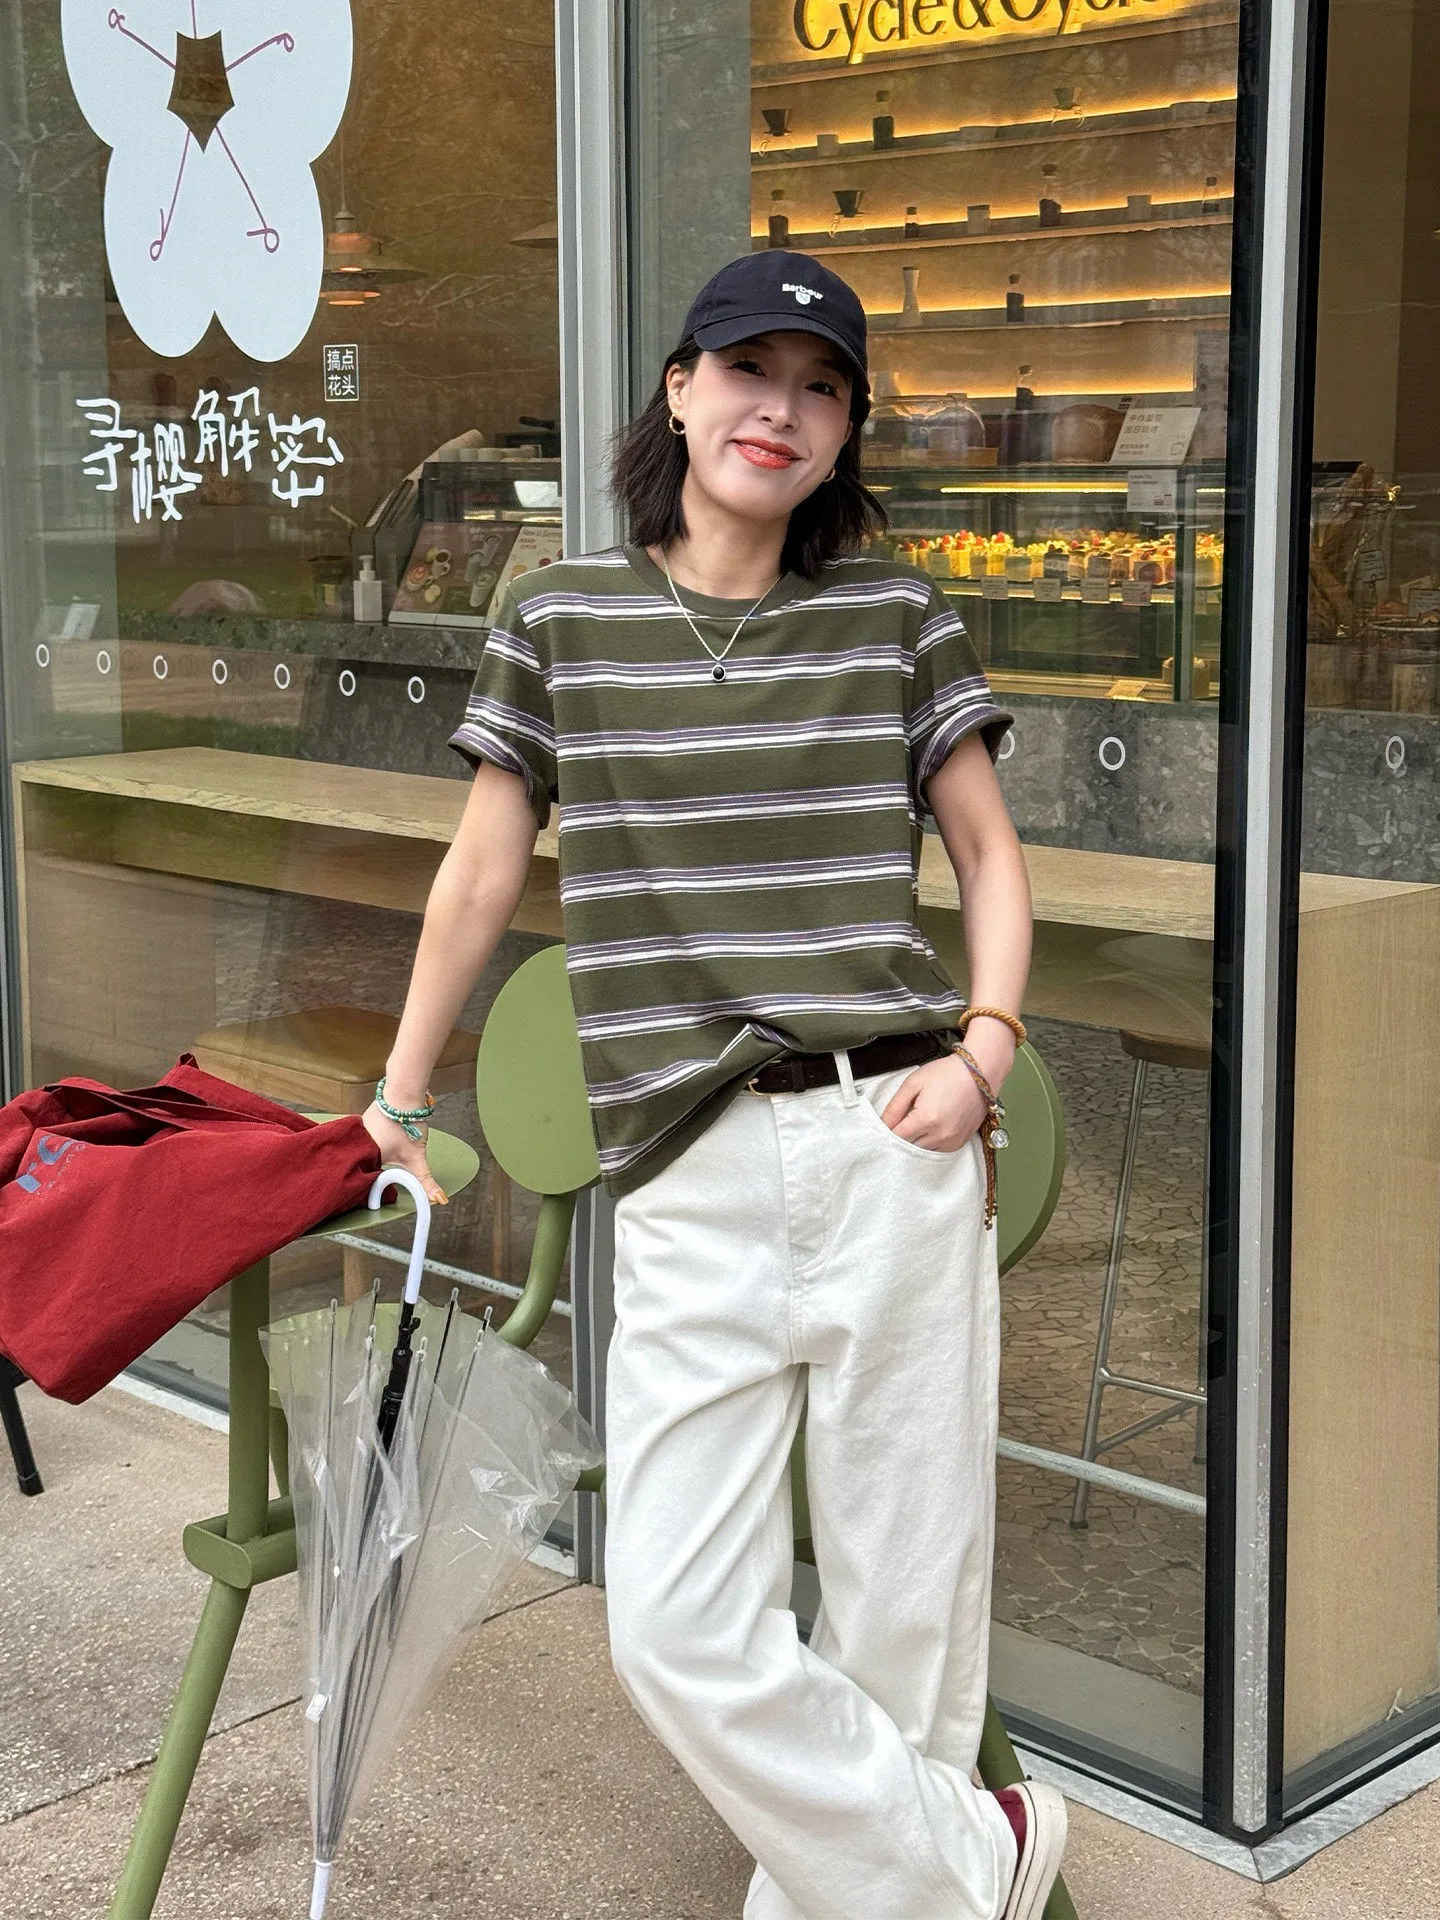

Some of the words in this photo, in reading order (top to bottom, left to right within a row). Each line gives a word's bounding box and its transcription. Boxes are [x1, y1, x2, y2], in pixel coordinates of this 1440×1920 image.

[326, 350, 354, 372] 搞点
[327, 375, 355, 397] 花头
[76, 386, 344, 523] 寻樱解密
